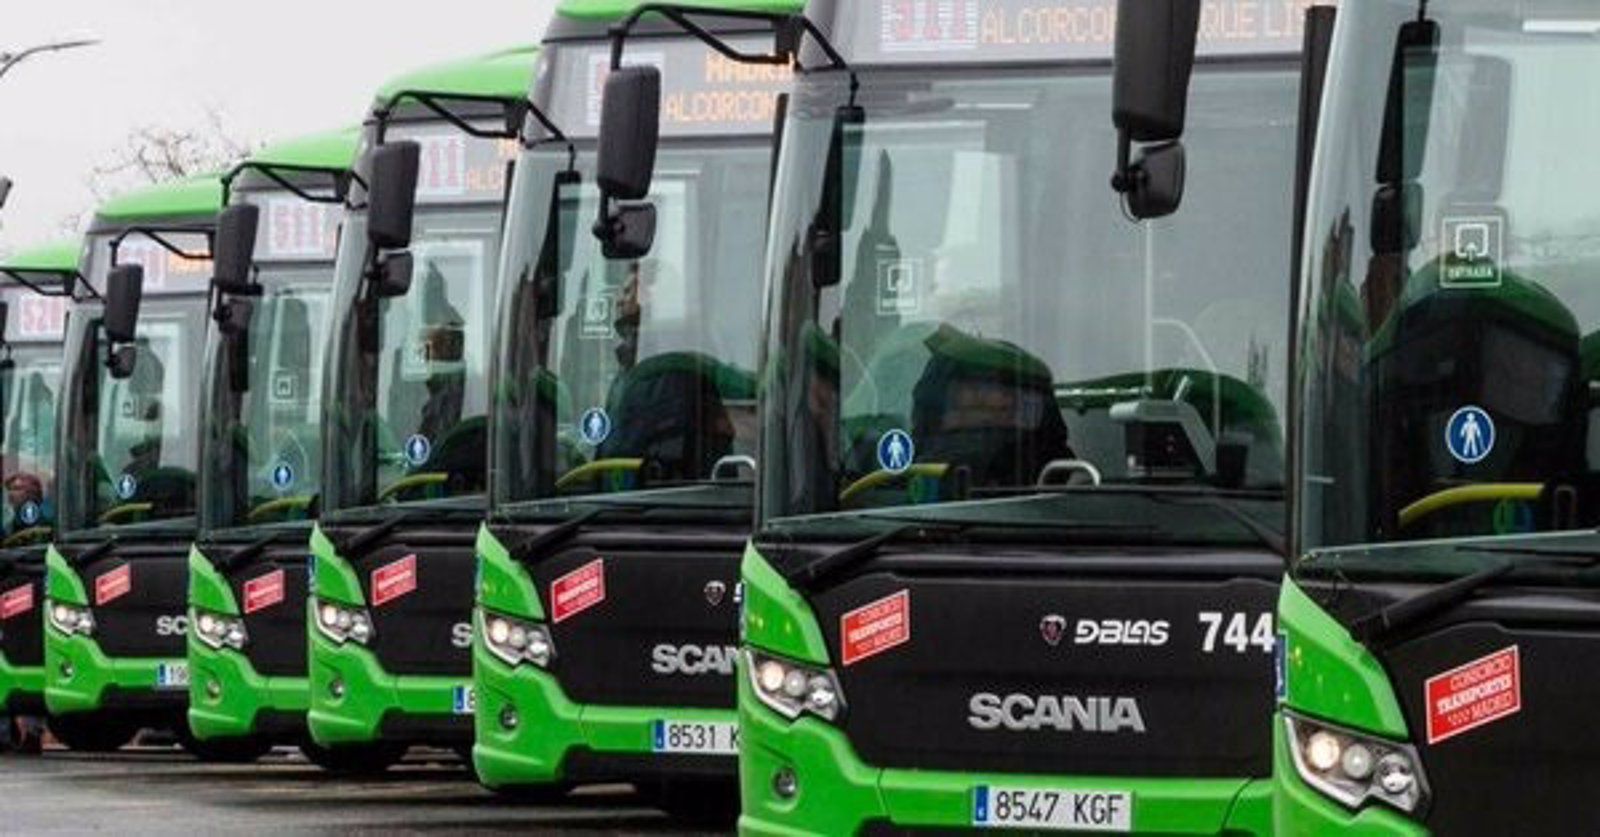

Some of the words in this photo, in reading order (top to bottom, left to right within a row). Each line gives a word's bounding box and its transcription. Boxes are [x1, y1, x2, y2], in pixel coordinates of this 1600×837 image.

[1199, 612, 1275, 652] 744
[968, 692, 1146, 732] SCANIA
[669, 724, 716, 749] 8531
[996, 790, 1060, 821] 8547
[1073, 793, 1124, 824] KGF
